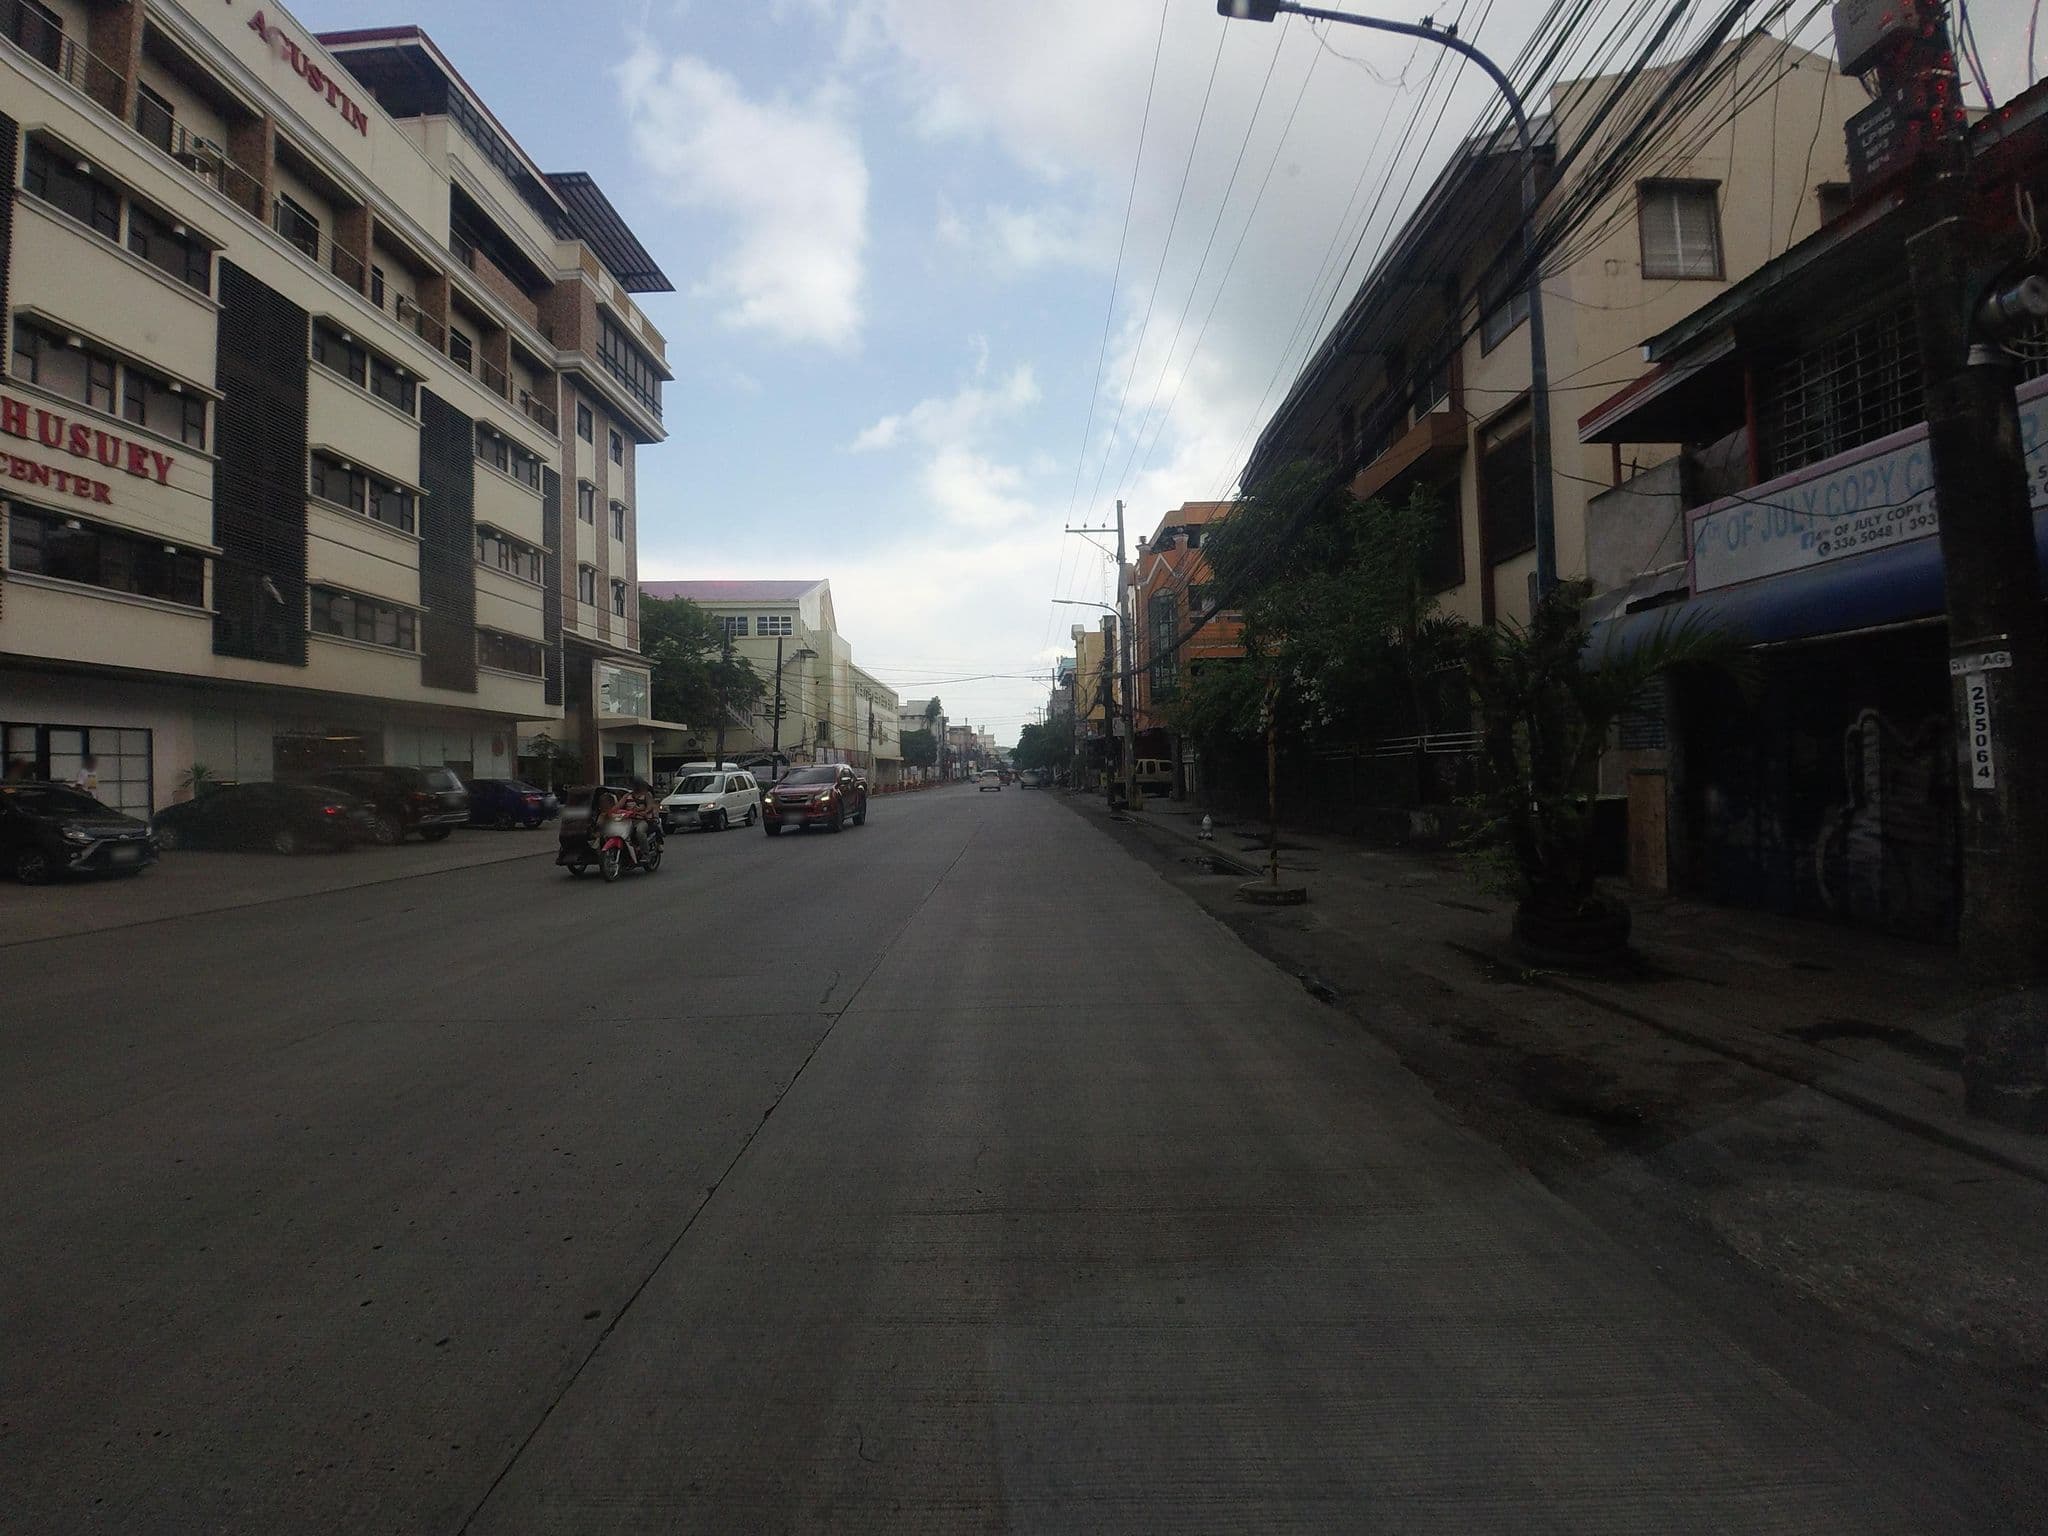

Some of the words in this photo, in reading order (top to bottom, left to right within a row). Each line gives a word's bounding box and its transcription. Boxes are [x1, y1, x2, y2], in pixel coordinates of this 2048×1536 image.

[1727, 511, 1753, 552] OF
[1761, 489, 1818, 540] JULY
[1824, 460, 1896, 521] COPY
[1834, 523, 1848, 536] OF
[1854, 516, 1881, 531] JULY
[1887, 502, 1922, 521] COPY
[1972, 686, 1989, 778] 255064
